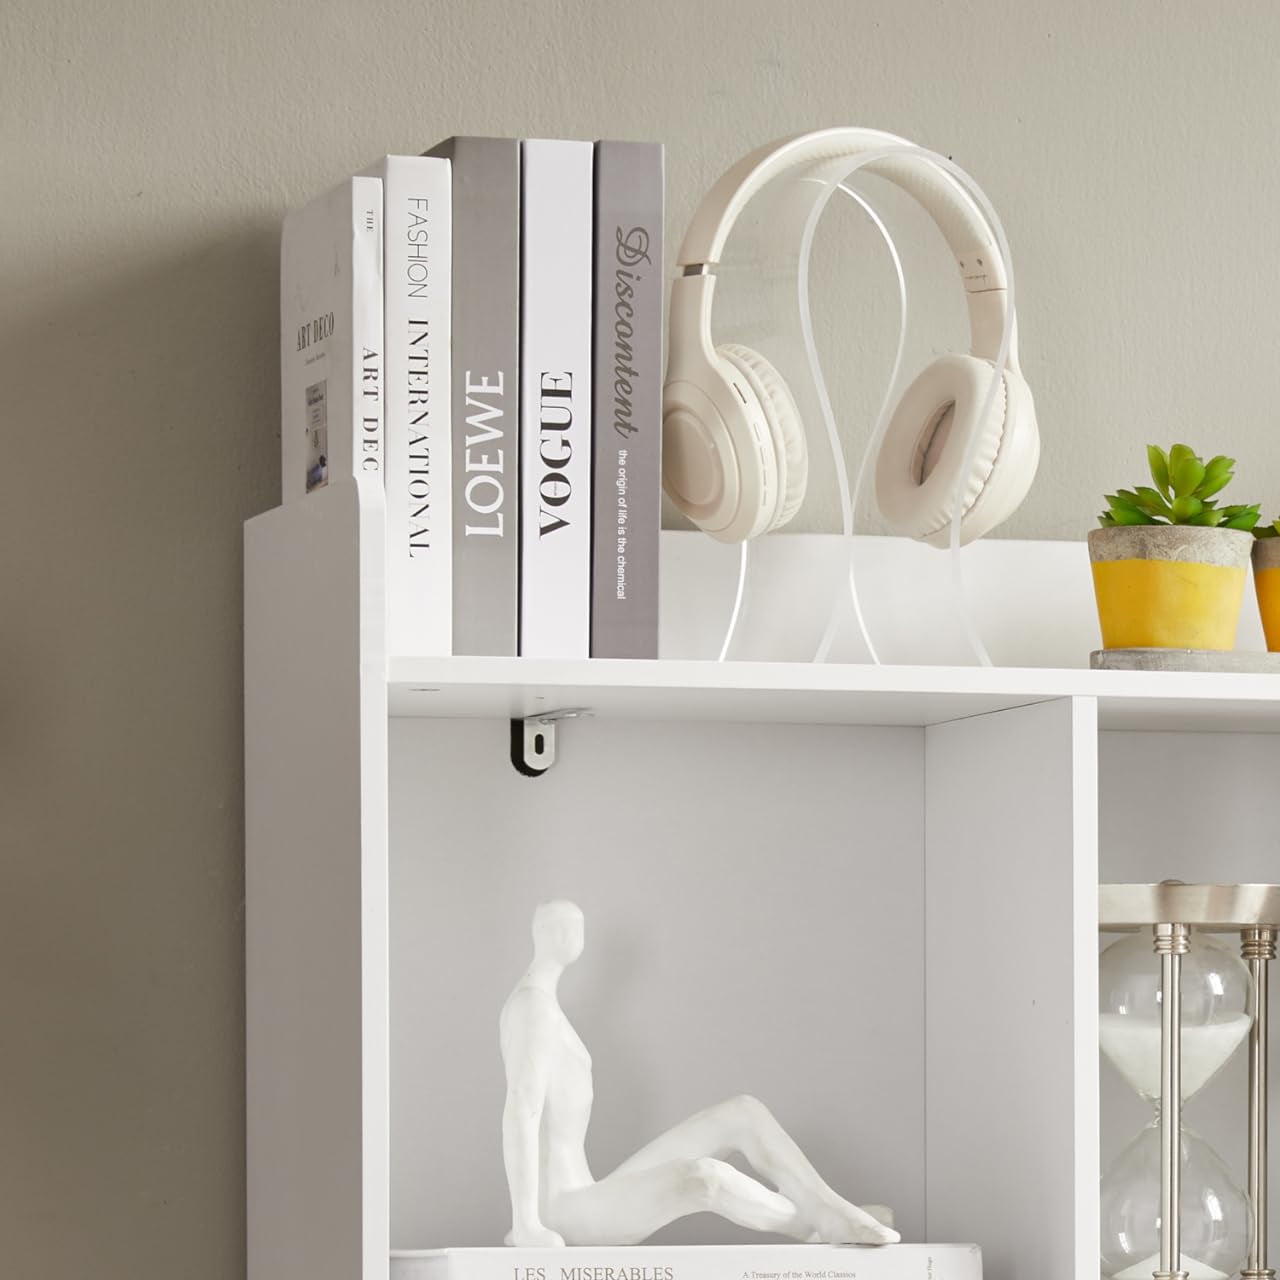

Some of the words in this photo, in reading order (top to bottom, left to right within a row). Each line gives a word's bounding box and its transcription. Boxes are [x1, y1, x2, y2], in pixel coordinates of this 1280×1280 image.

[407, 198, 428, 297] FASHION
[296, 323, 311, 352] ART
[614, 226, 651, 439] Discontent
[363, 348, 378, 401] ART
[363, 418, 378, 470] DEC
[408, 320, 429, 557] INTERNATIONAL
[465, 371, 504, 537] LOEWE
[538, 371, 573, 539] VOGUE
[619, 450, 628, 465] the
[616, 468, 628, 495] origin
[618, 498, 627, 508] of
[618, 510, 627, 524] life
[618, 527, 627, 535] is
[618, 538, 627, 553] the
[617, 556, 627, 599] chemical
[560, 1267, 673, 1280] MISERABLES
[751, 1271, 781, 1280] Treasury
[783, 1271, 790, 1279] of
[804, 1271, 826, 1279] World
